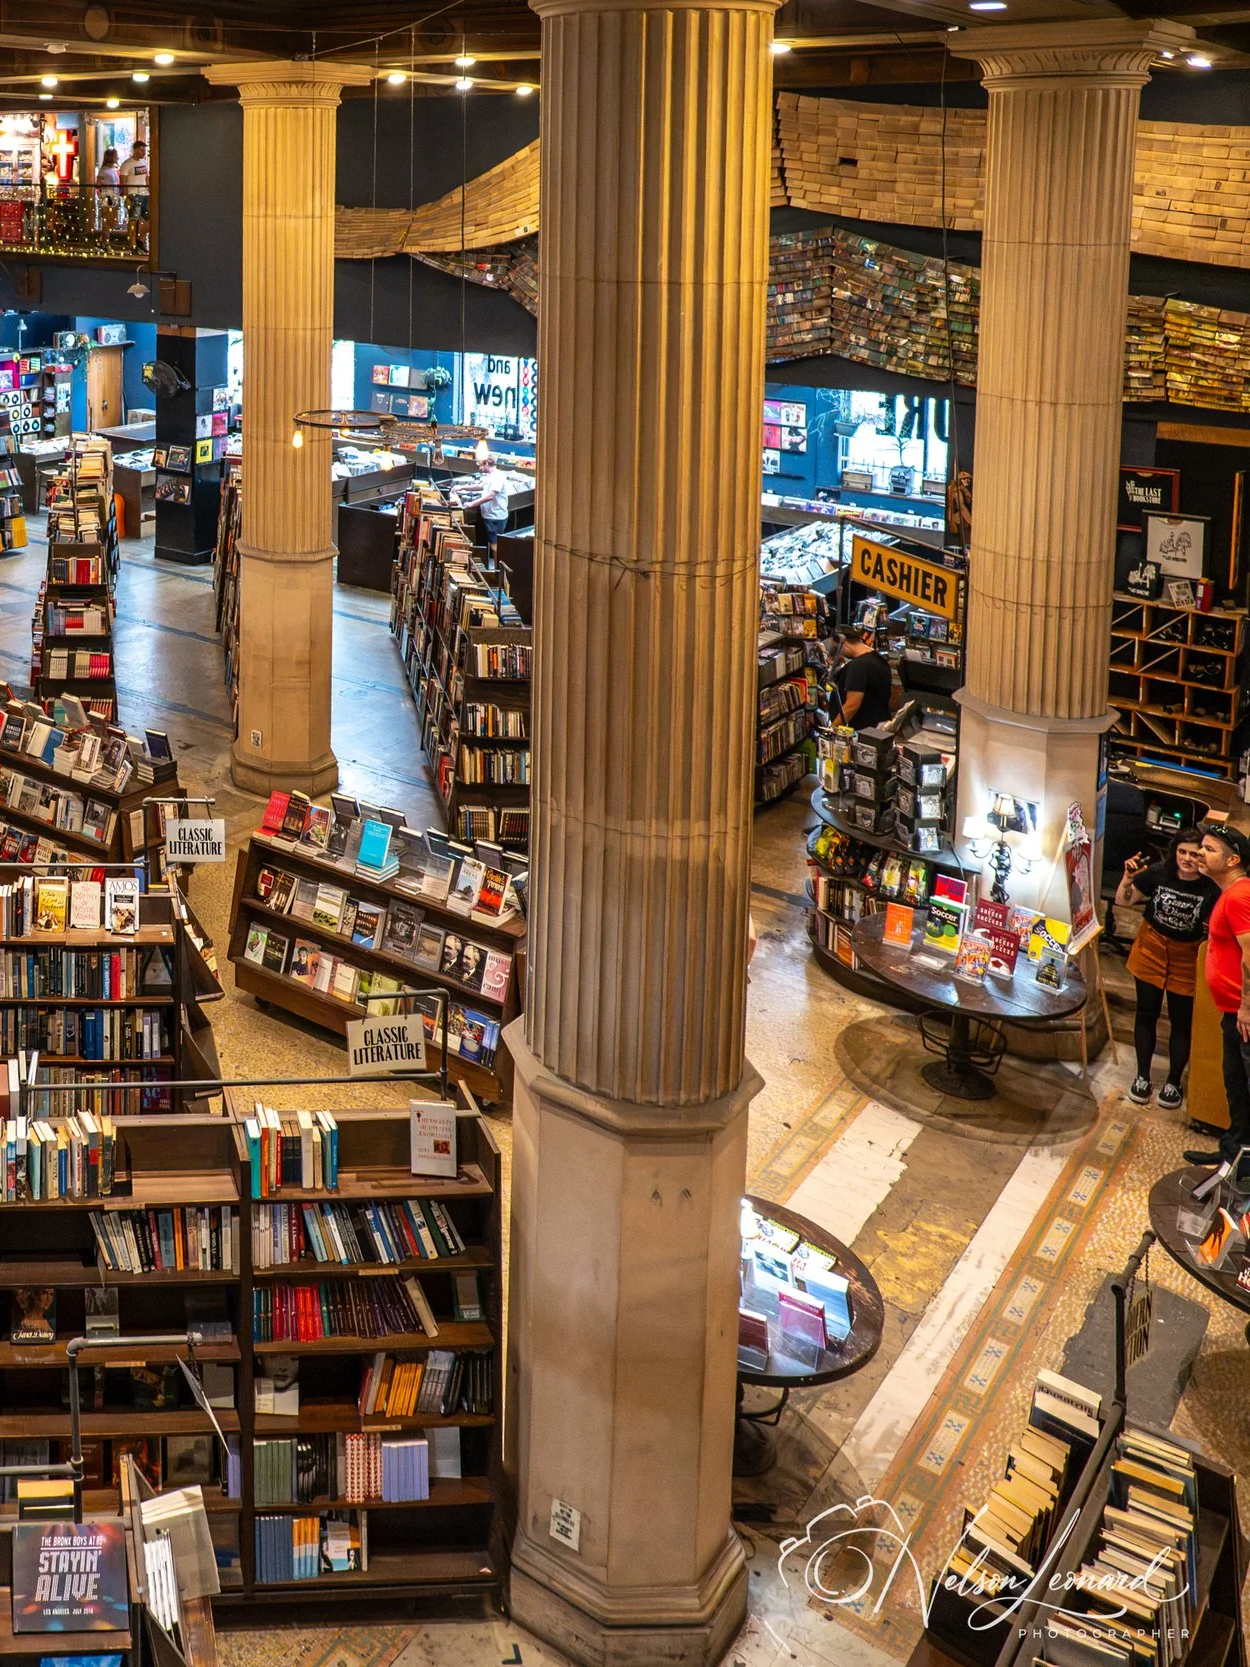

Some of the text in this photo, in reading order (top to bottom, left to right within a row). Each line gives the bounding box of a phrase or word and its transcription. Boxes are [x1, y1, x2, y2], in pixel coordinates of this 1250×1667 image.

[860, 548, 948, 608] CASHIER
[178, 828, 213, 841] CLASSIC
[170, 841, 222, 855] LITERATURE
[931, 906, 958, 922] Soccer
[364, 1026, 408, 1046] CLASSIC
[354, 1043, 421, 1065] LITERATURE
[41, 1537, 51, 1546] THE
[53, 1536, 71, 1546] BRONX
[72, 1536, 87, 1546] BOYS
[89, 1536, 96, 1545] AT
[39, 1551, 102, 1573] STAYIN'
[35, 1574, 100, 1601] ALIVE
